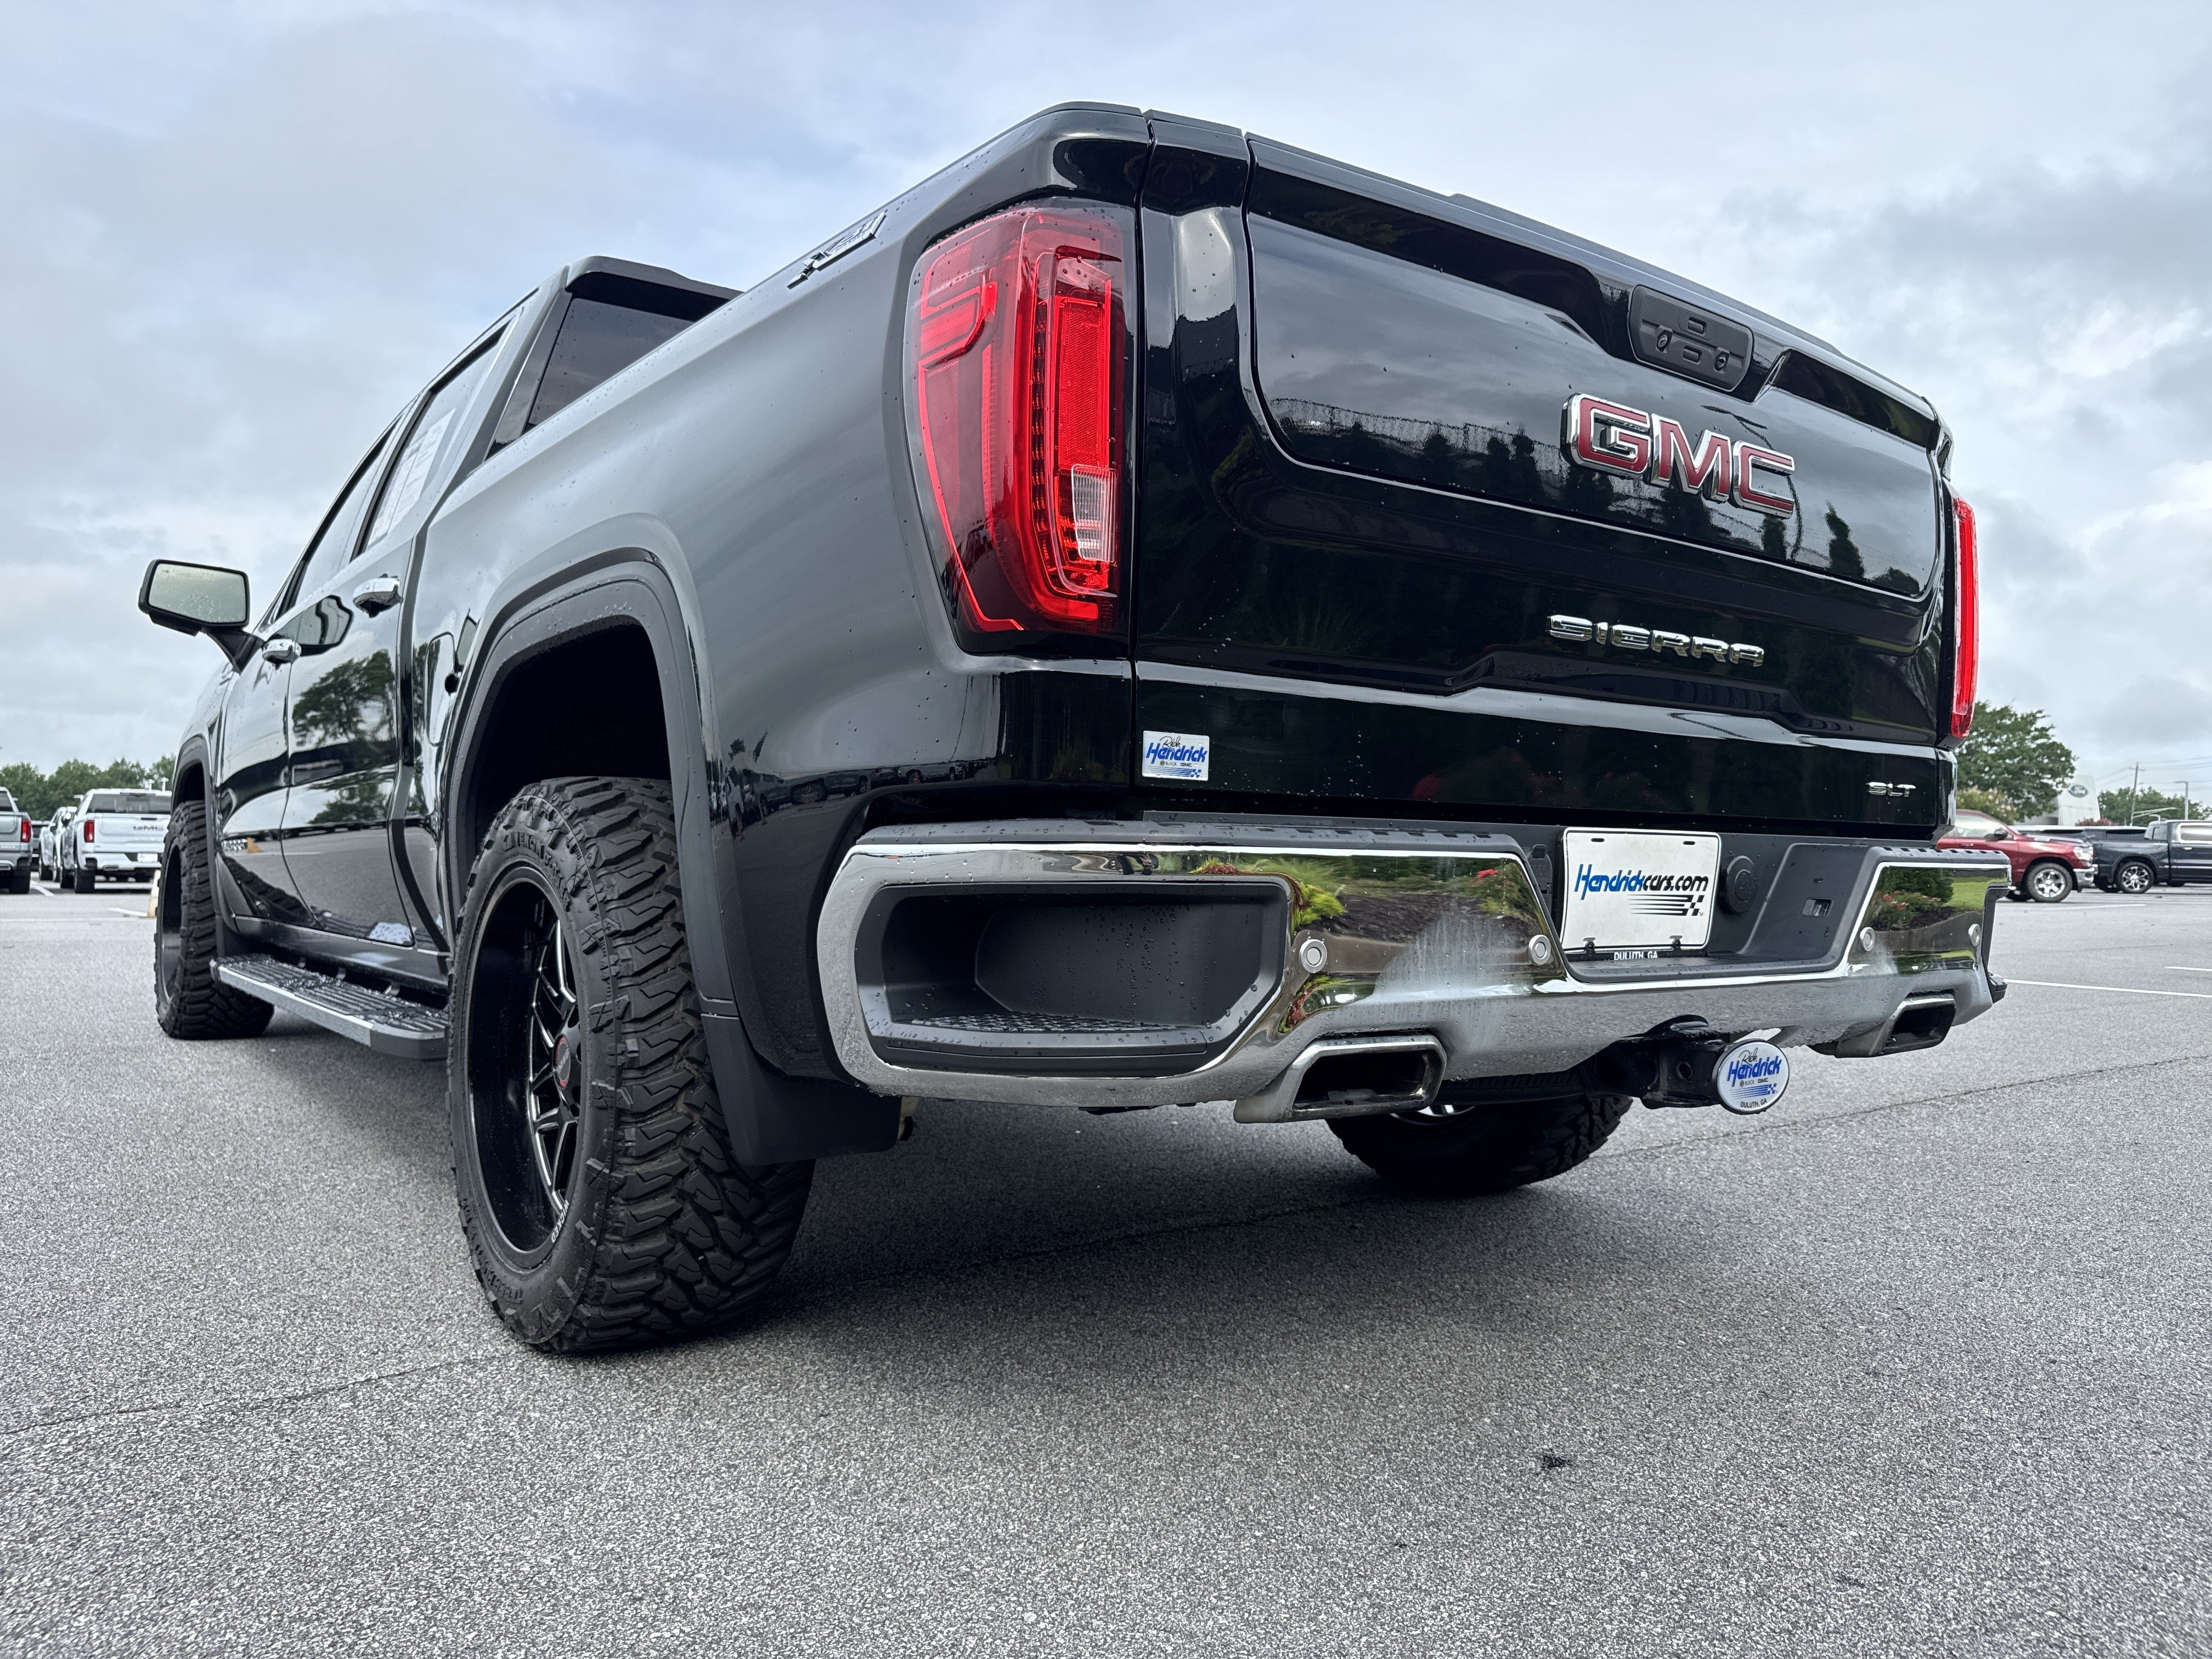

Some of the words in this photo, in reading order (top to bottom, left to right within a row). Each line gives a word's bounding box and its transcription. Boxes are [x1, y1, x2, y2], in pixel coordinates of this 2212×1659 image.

[1560, 393, 1796, 519] GMC
[1549, 614, 1765, 668] SIERRA
[1146, 742, 1208, 764] Hendrick
[1160, 736, 1181, 750] Rick
[1867, 781, 1916, 798] SLT
[1574, 864, 1709, 900] Hendrickcars.com
[1647, 951, 1658, 959] GA
[1738, 1047, 1758, 1067] Rick
[1726, 1055, 1782, 1087] Hendrick
[551, 1199, 570, 1244] WICKED
